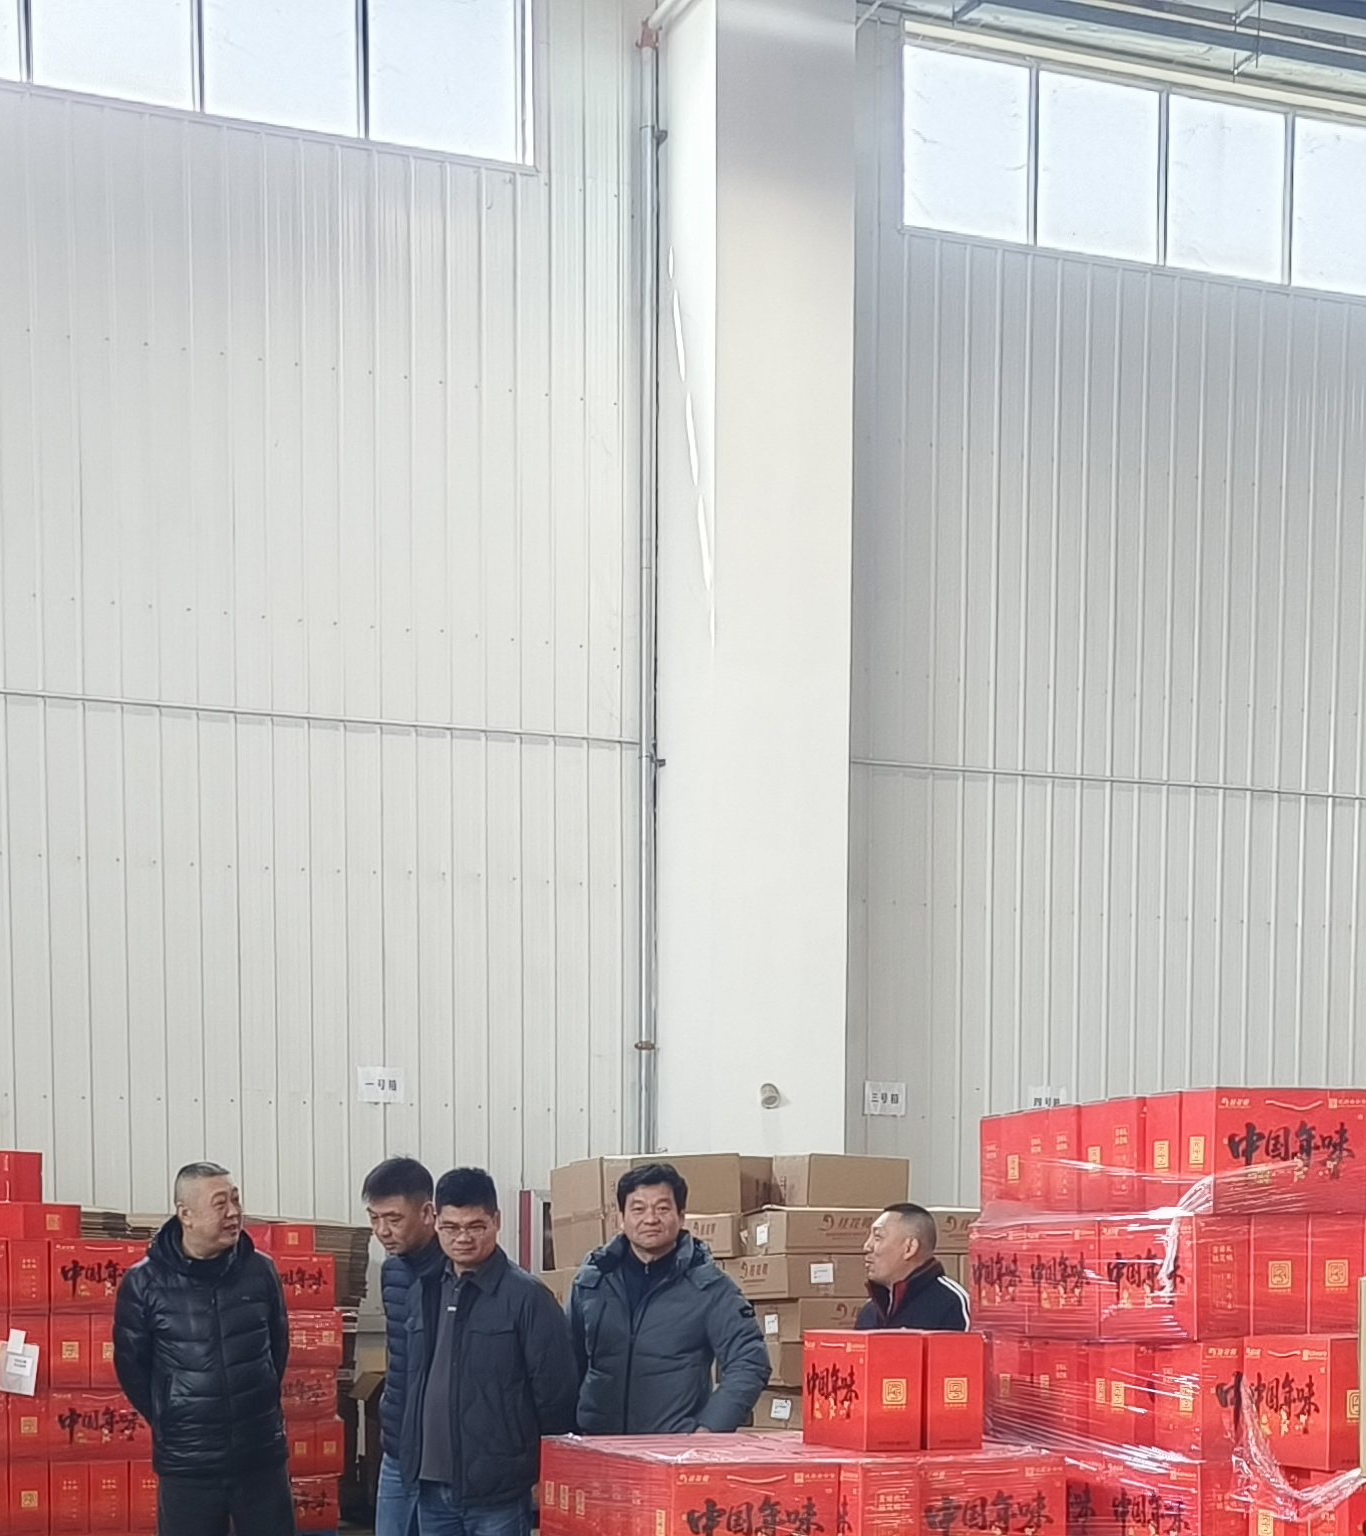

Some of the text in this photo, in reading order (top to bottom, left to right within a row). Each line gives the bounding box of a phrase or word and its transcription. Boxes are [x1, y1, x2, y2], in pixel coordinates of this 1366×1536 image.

[1228, 1122, 1355, 1180] 中国年味
[61, 1259, 124, 1298] 中国年
[807, 1363, 859, 1420] 中国年味
[1251, 1372, 1319, 1434] 中国年味
